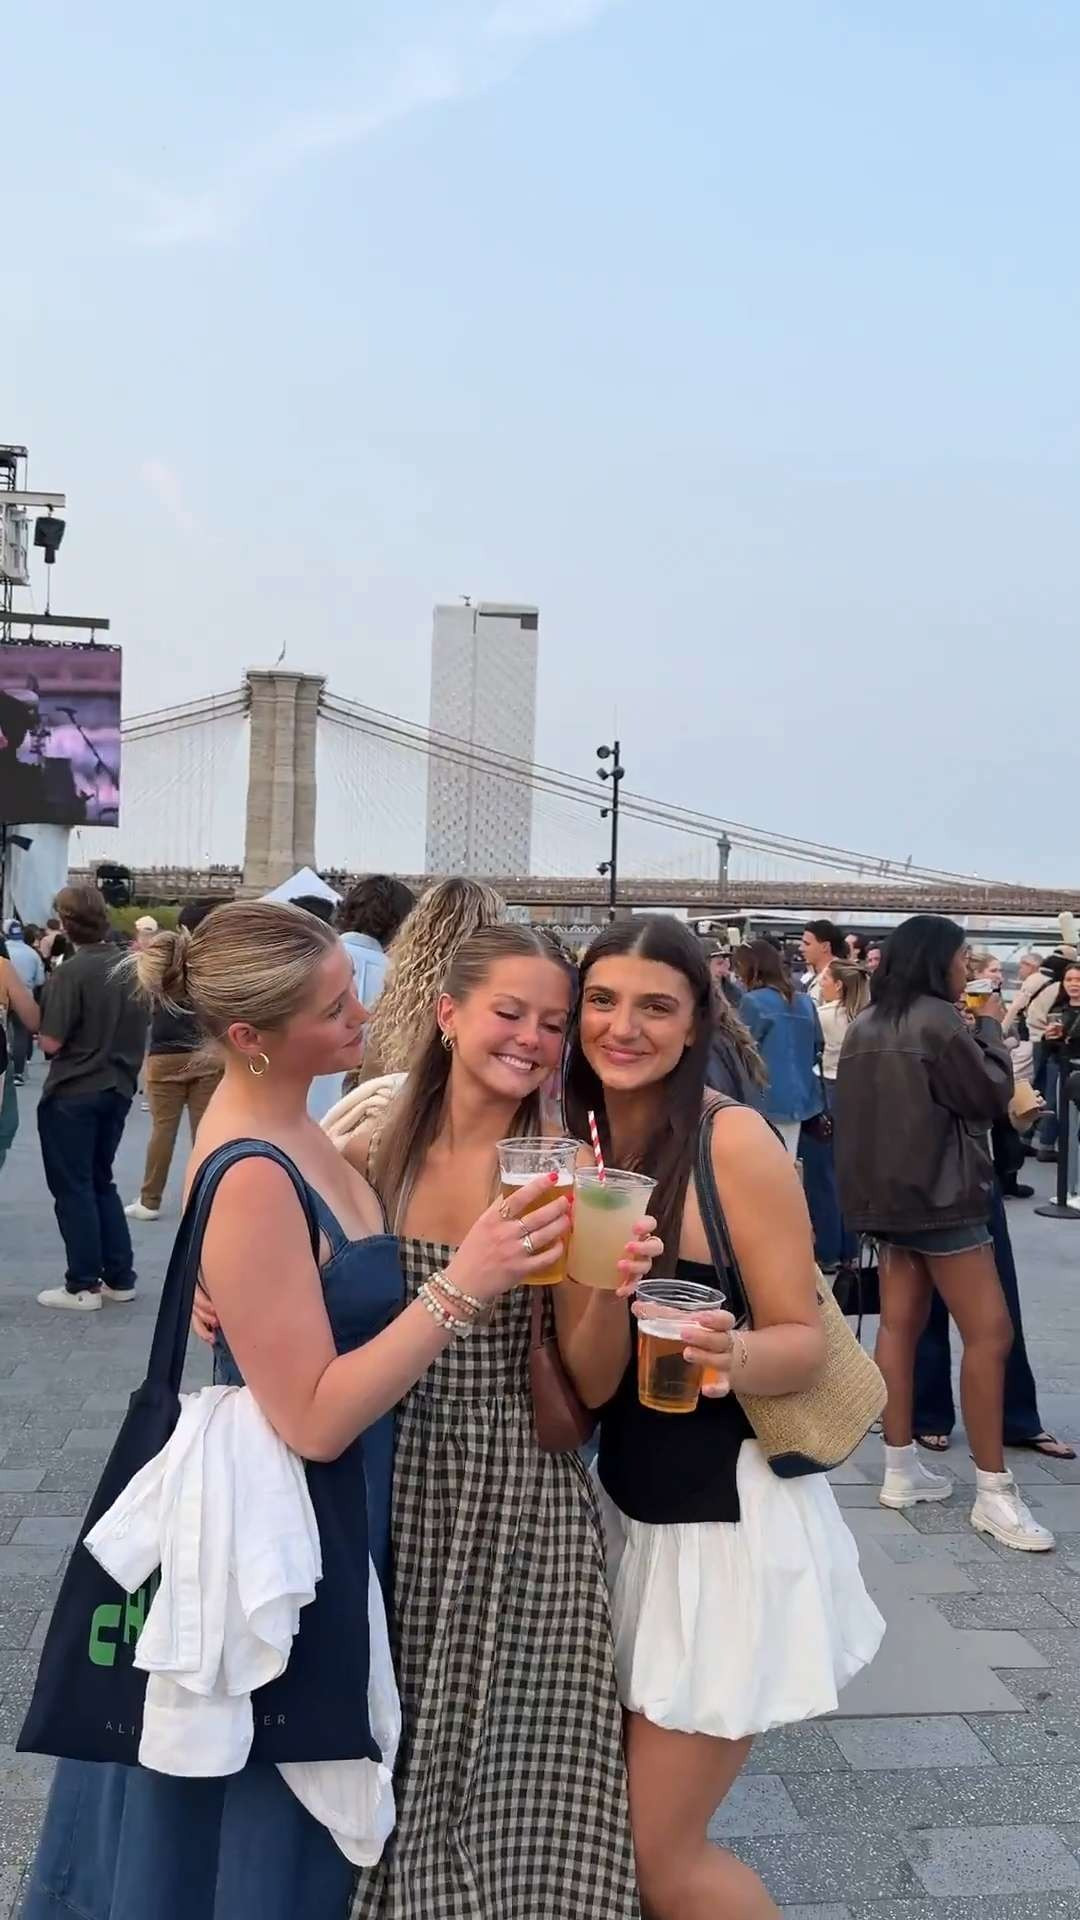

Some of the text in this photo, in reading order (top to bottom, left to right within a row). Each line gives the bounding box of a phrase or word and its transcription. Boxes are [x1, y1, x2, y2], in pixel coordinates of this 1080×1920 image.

[89, 1570, 160, 1666] CH
[105, 1714, 286, 1735] ALI ER
